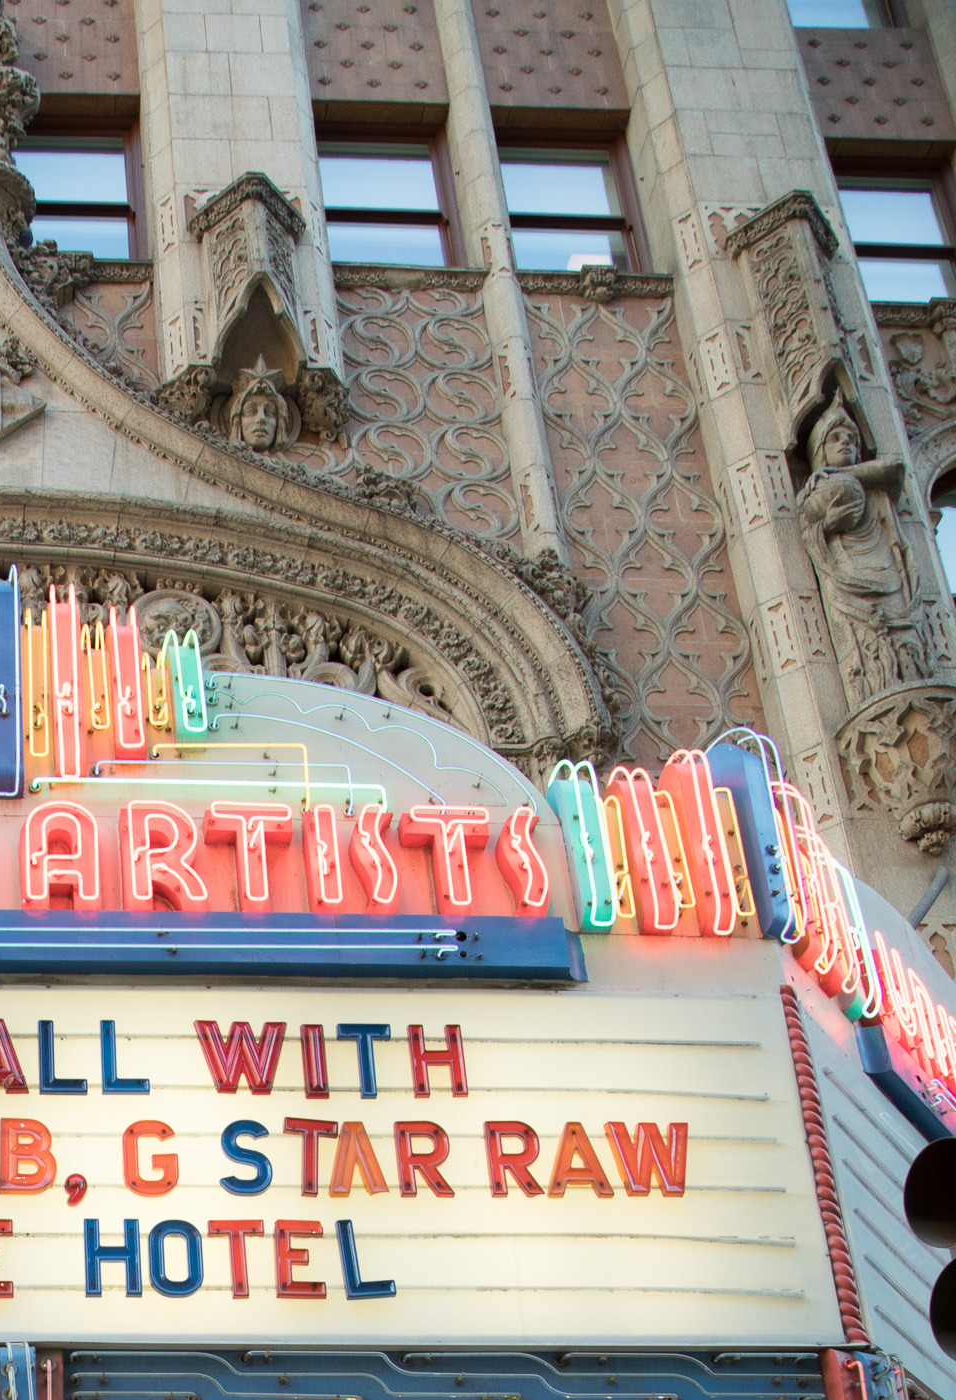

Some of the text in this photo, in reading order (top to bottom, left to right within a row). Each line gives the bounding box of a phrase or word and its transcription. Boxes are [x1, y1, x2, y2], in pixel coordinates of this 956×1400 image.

[19, 800, 550, 916] ARTISTS
[194, 1020, 470, 1099] WITH
[122, 1120, 180, 1198] G
[219, 1116, 455, 1198] STAR
[483, 1120, 690, 1199] RAW
[83, 1218, 397, 1300] HOTEL
